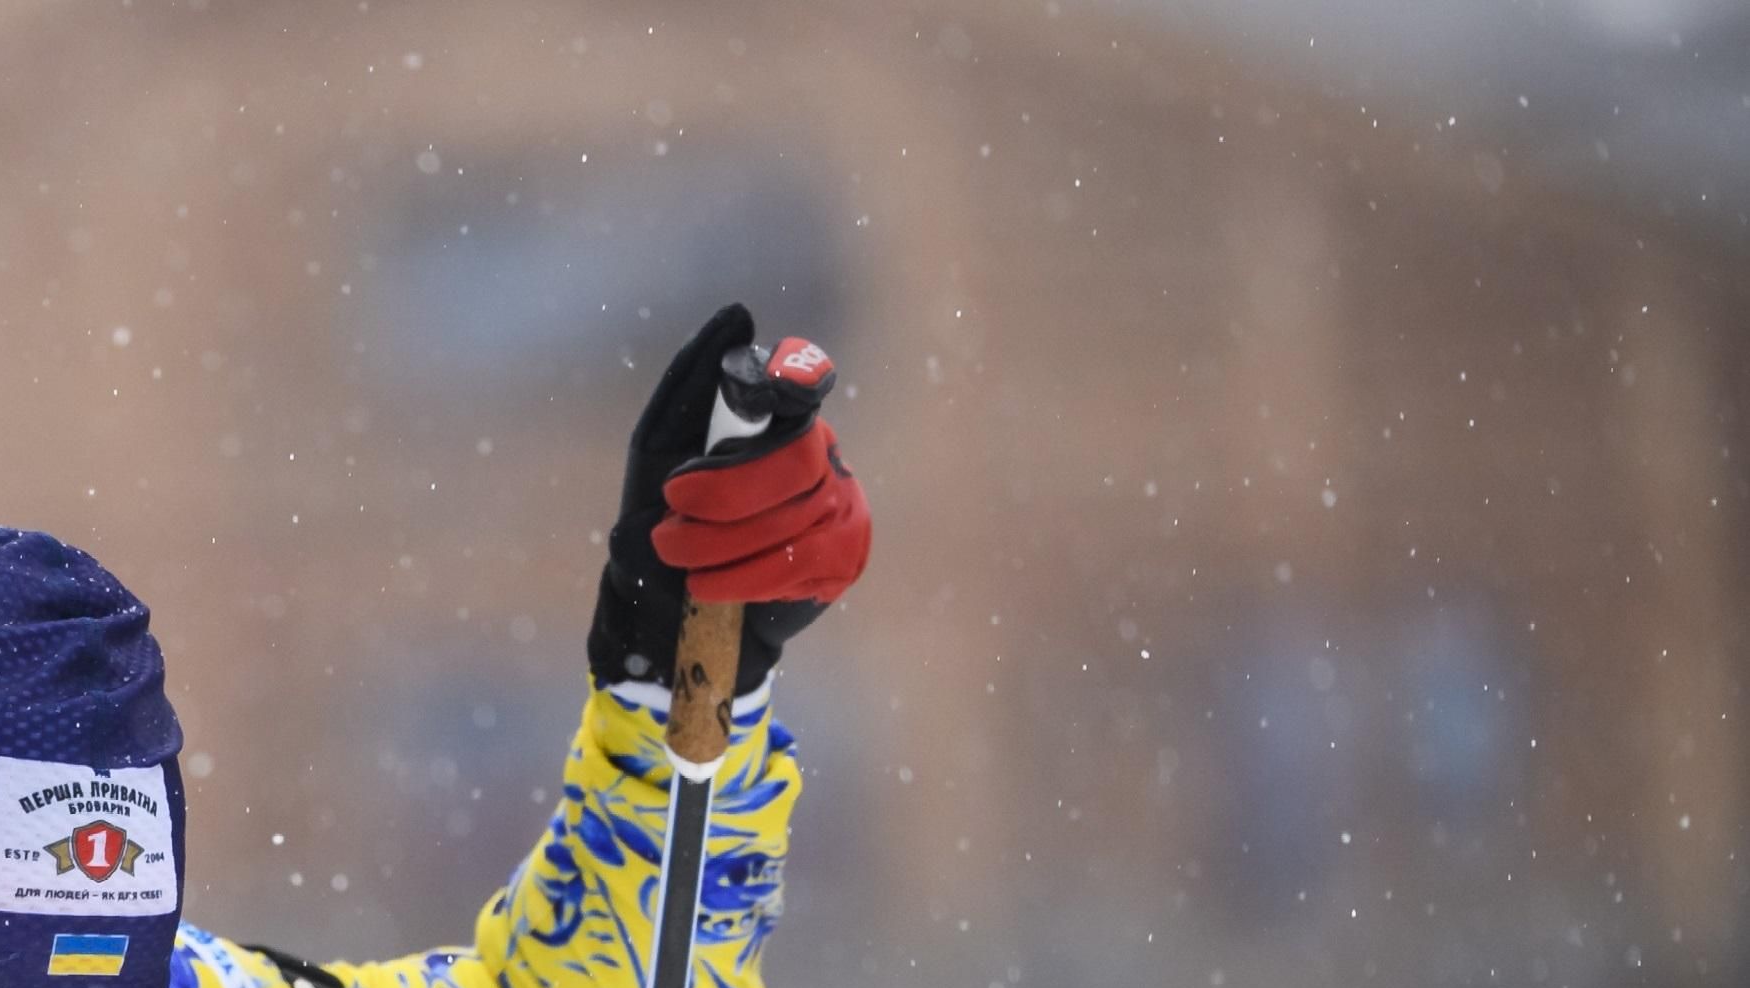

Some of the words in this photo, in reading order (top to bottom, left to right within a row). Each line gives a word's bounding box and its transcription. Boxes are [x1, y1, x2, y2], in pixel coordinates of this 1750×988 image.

[18, 782, 84, 814] ПЕРША
[90, 781, 158, 817] ПРИВАТНА
[15, 887, 41, 898] ДЛЯ
[45, 889, 90, 900] ЛЮДЕЙ
